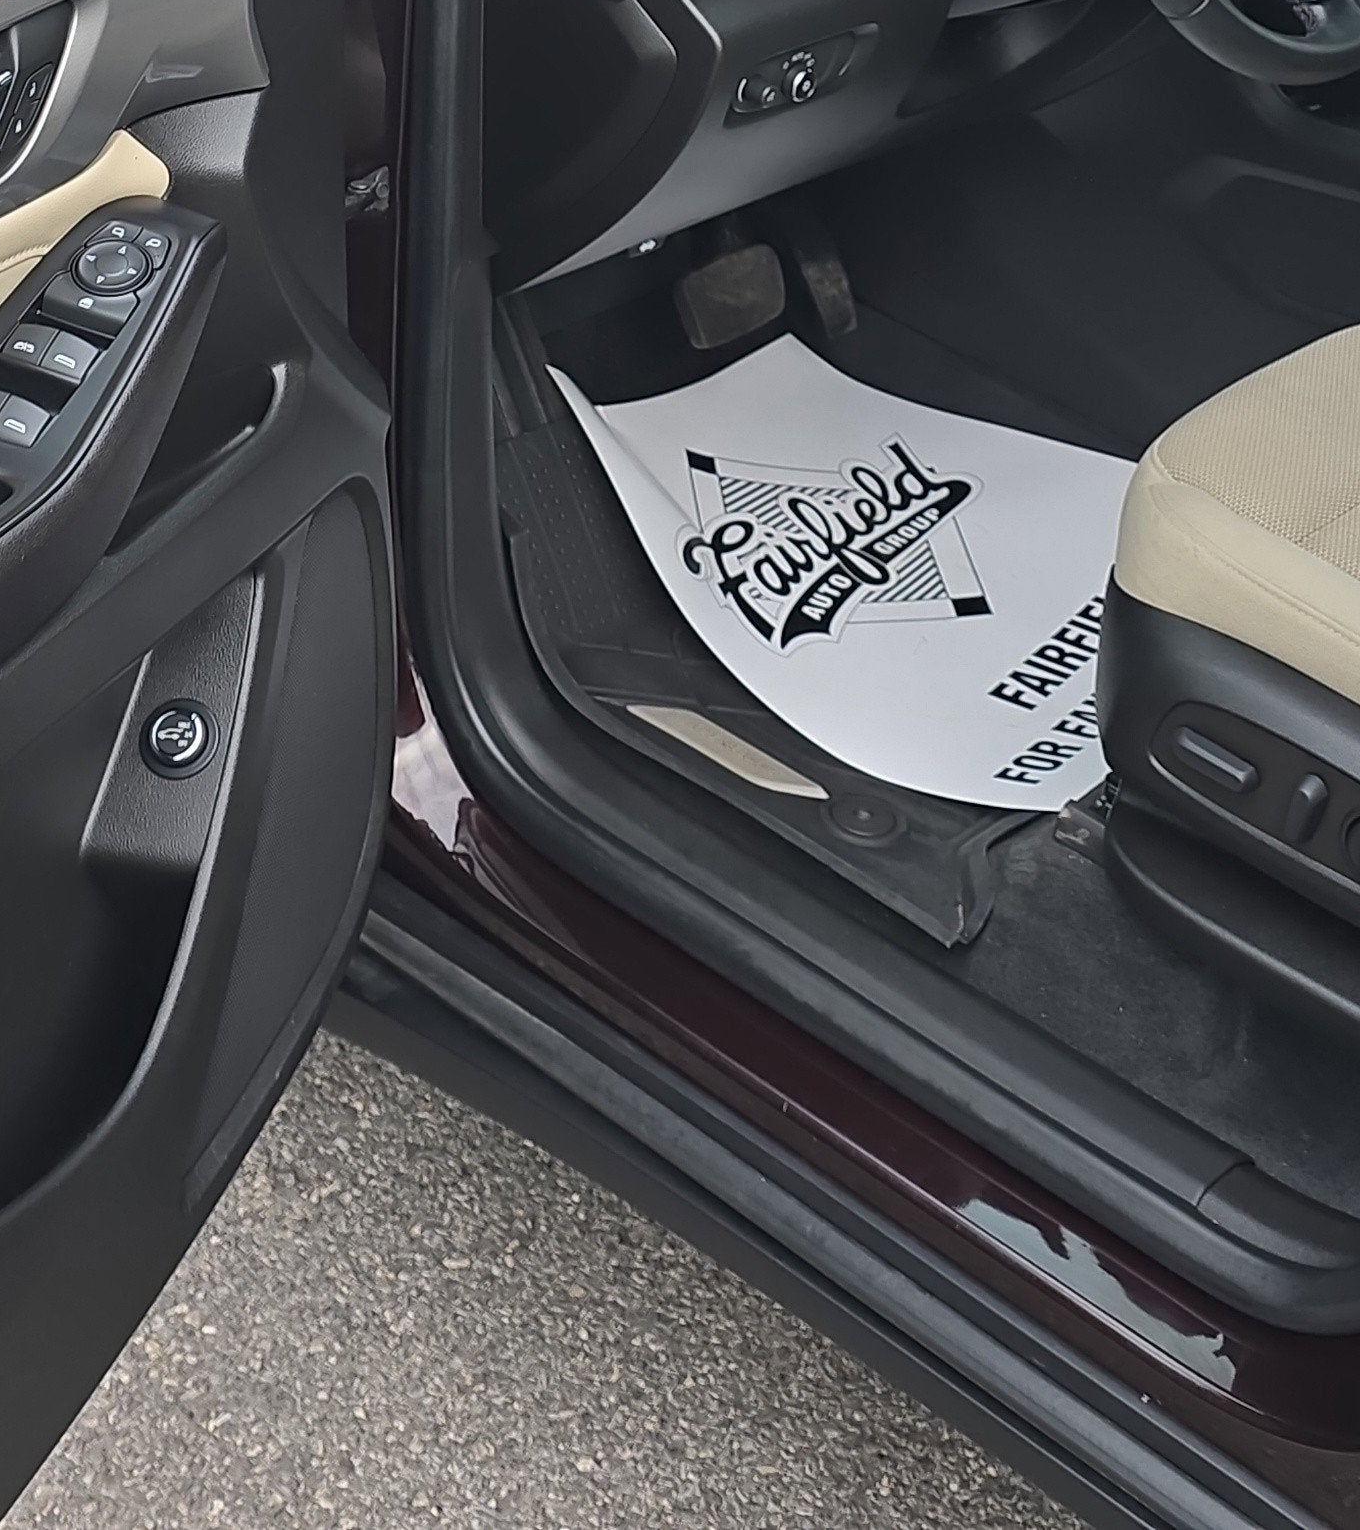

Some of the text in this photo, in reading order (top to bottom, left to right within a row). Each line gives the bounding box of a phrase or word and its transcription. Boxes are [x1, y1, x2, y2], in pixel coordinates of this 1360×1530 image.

[683, 442, 952, 643] Fairfield
[800, 507, 941, 622] AUTO GROUP
[992, 740, 1084, 785] FOR
